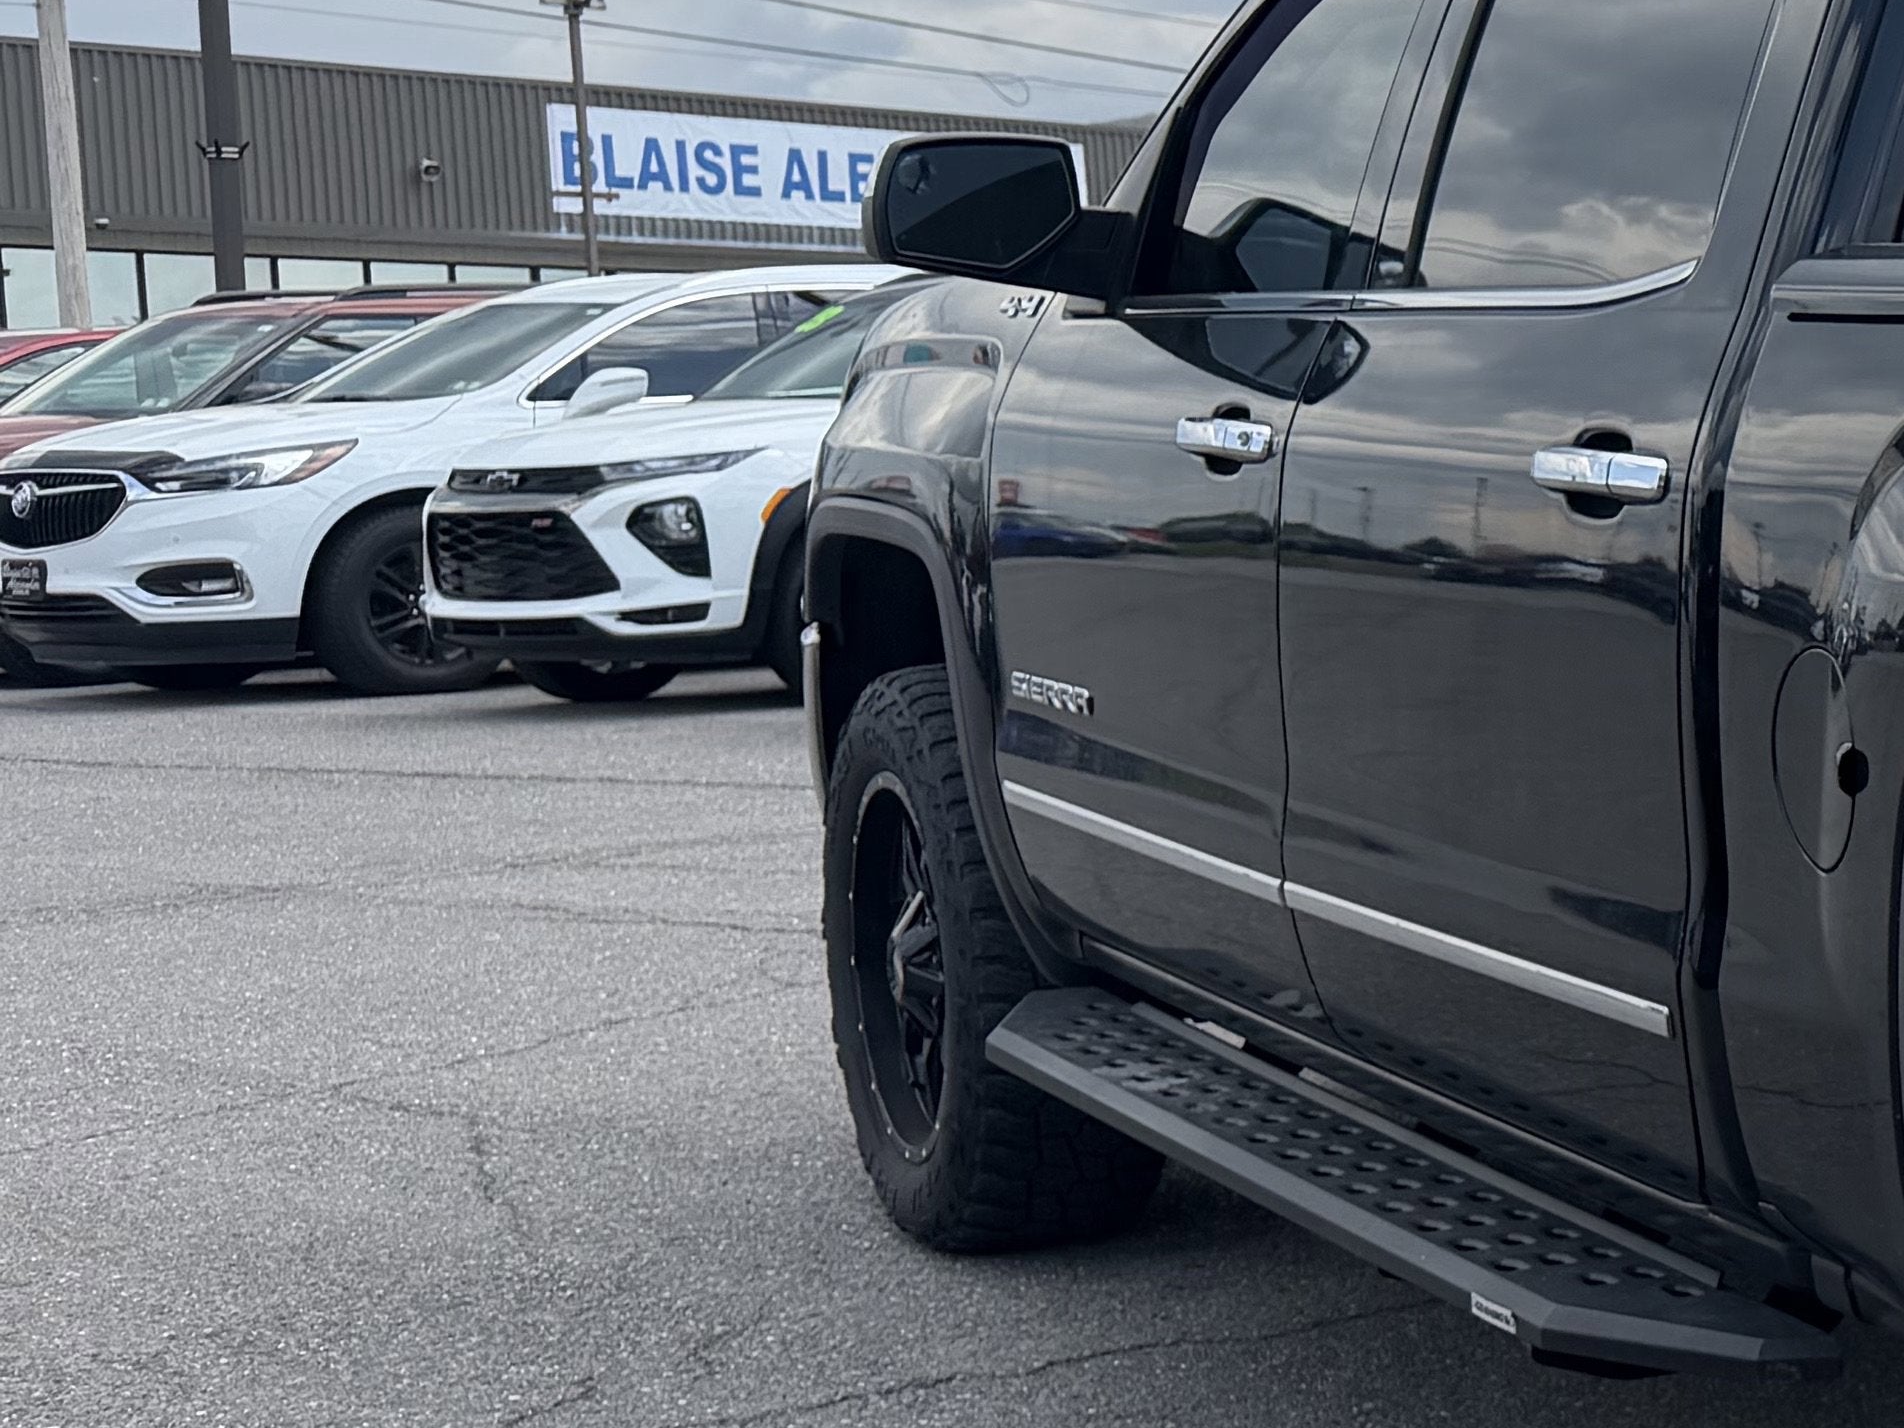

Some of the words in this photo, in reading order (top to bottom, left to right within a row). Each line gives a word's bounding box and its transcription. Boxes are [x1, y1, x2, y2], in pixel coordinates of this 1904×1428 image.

[560, 130, 762, 197] BLAISE
[781, 148, 876, 203] ALE
[1010, 670, 1092, 716] SIERRA
